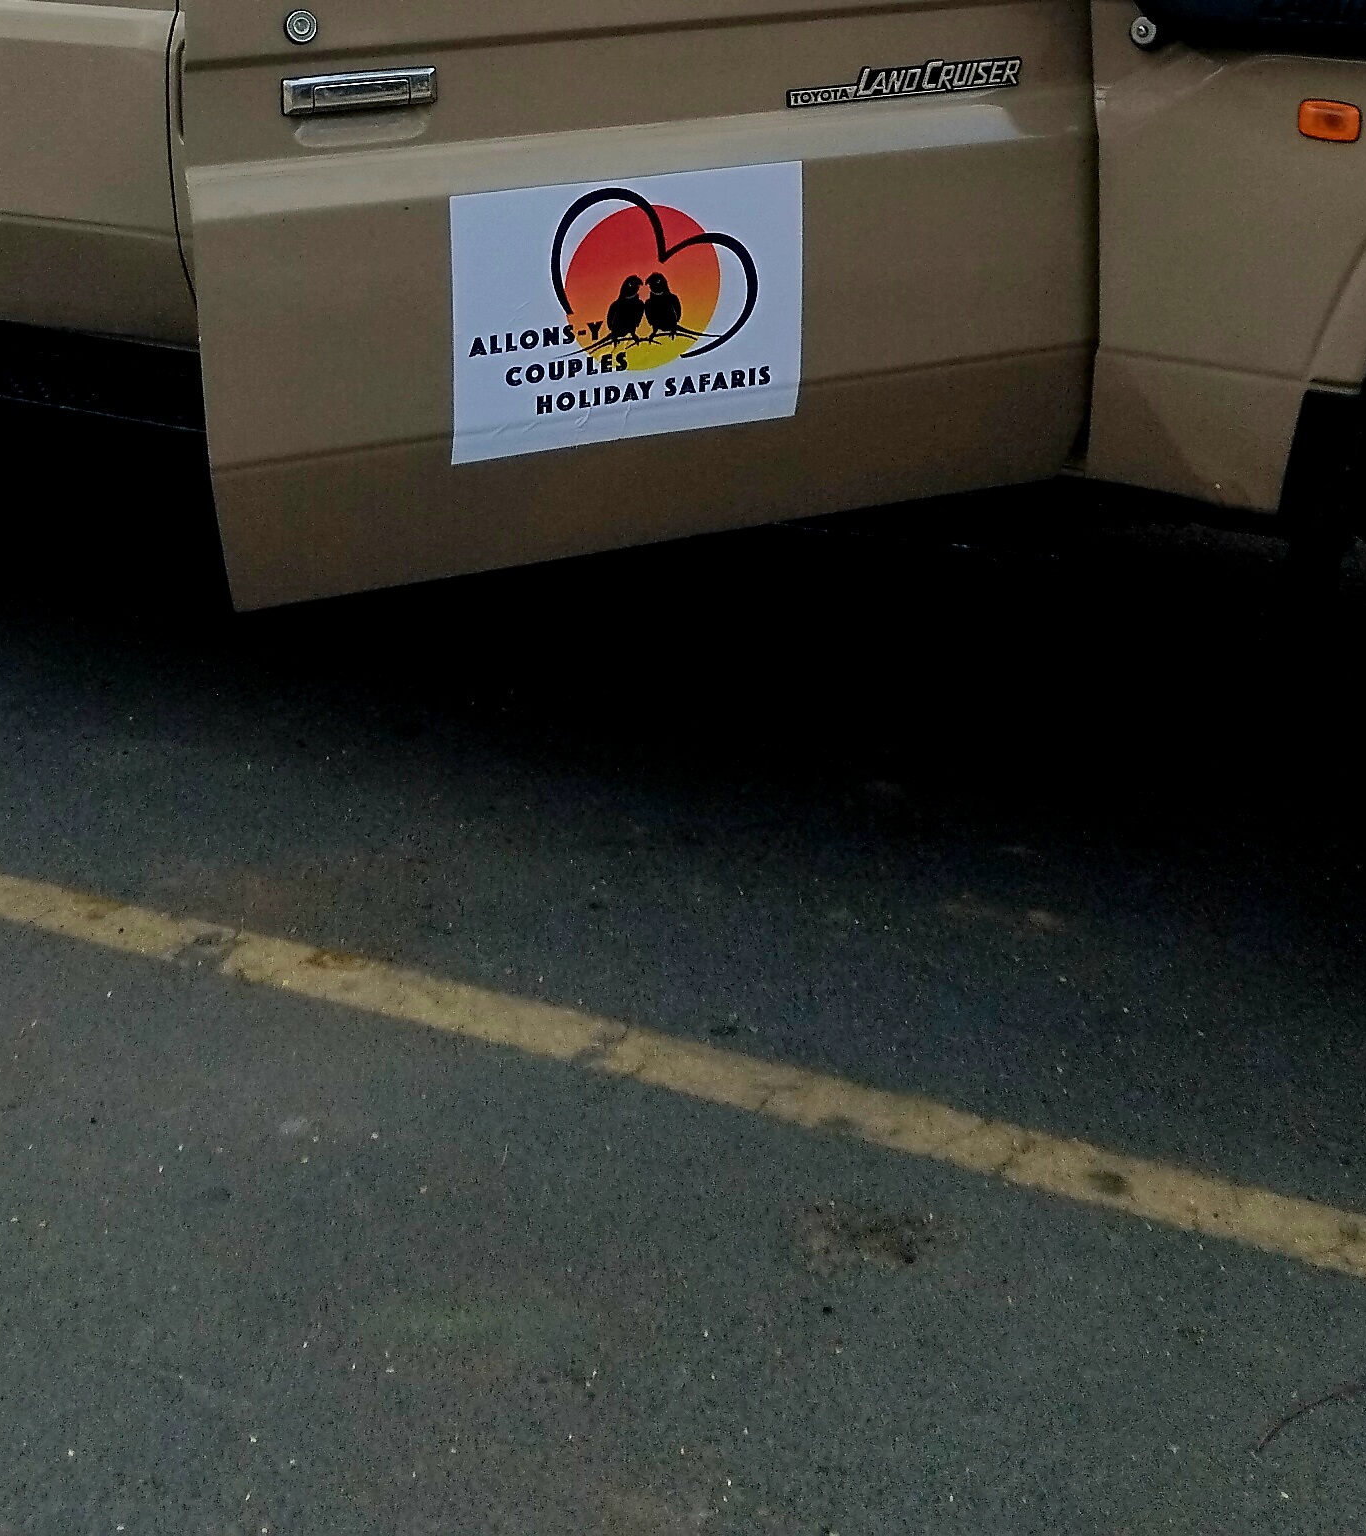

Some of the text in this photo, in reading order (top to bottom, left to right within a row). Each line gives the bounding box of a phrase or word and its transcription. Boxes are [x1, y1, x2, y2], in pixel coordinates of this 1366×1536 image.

[791, 87, 850, 105] TOYOTA
[468, 319, 604, 358] ALLONS-Y
[505, 351, 628, 387] COUPLES
[536, 365, 771, 415] HOLIDAY SAFARIS
